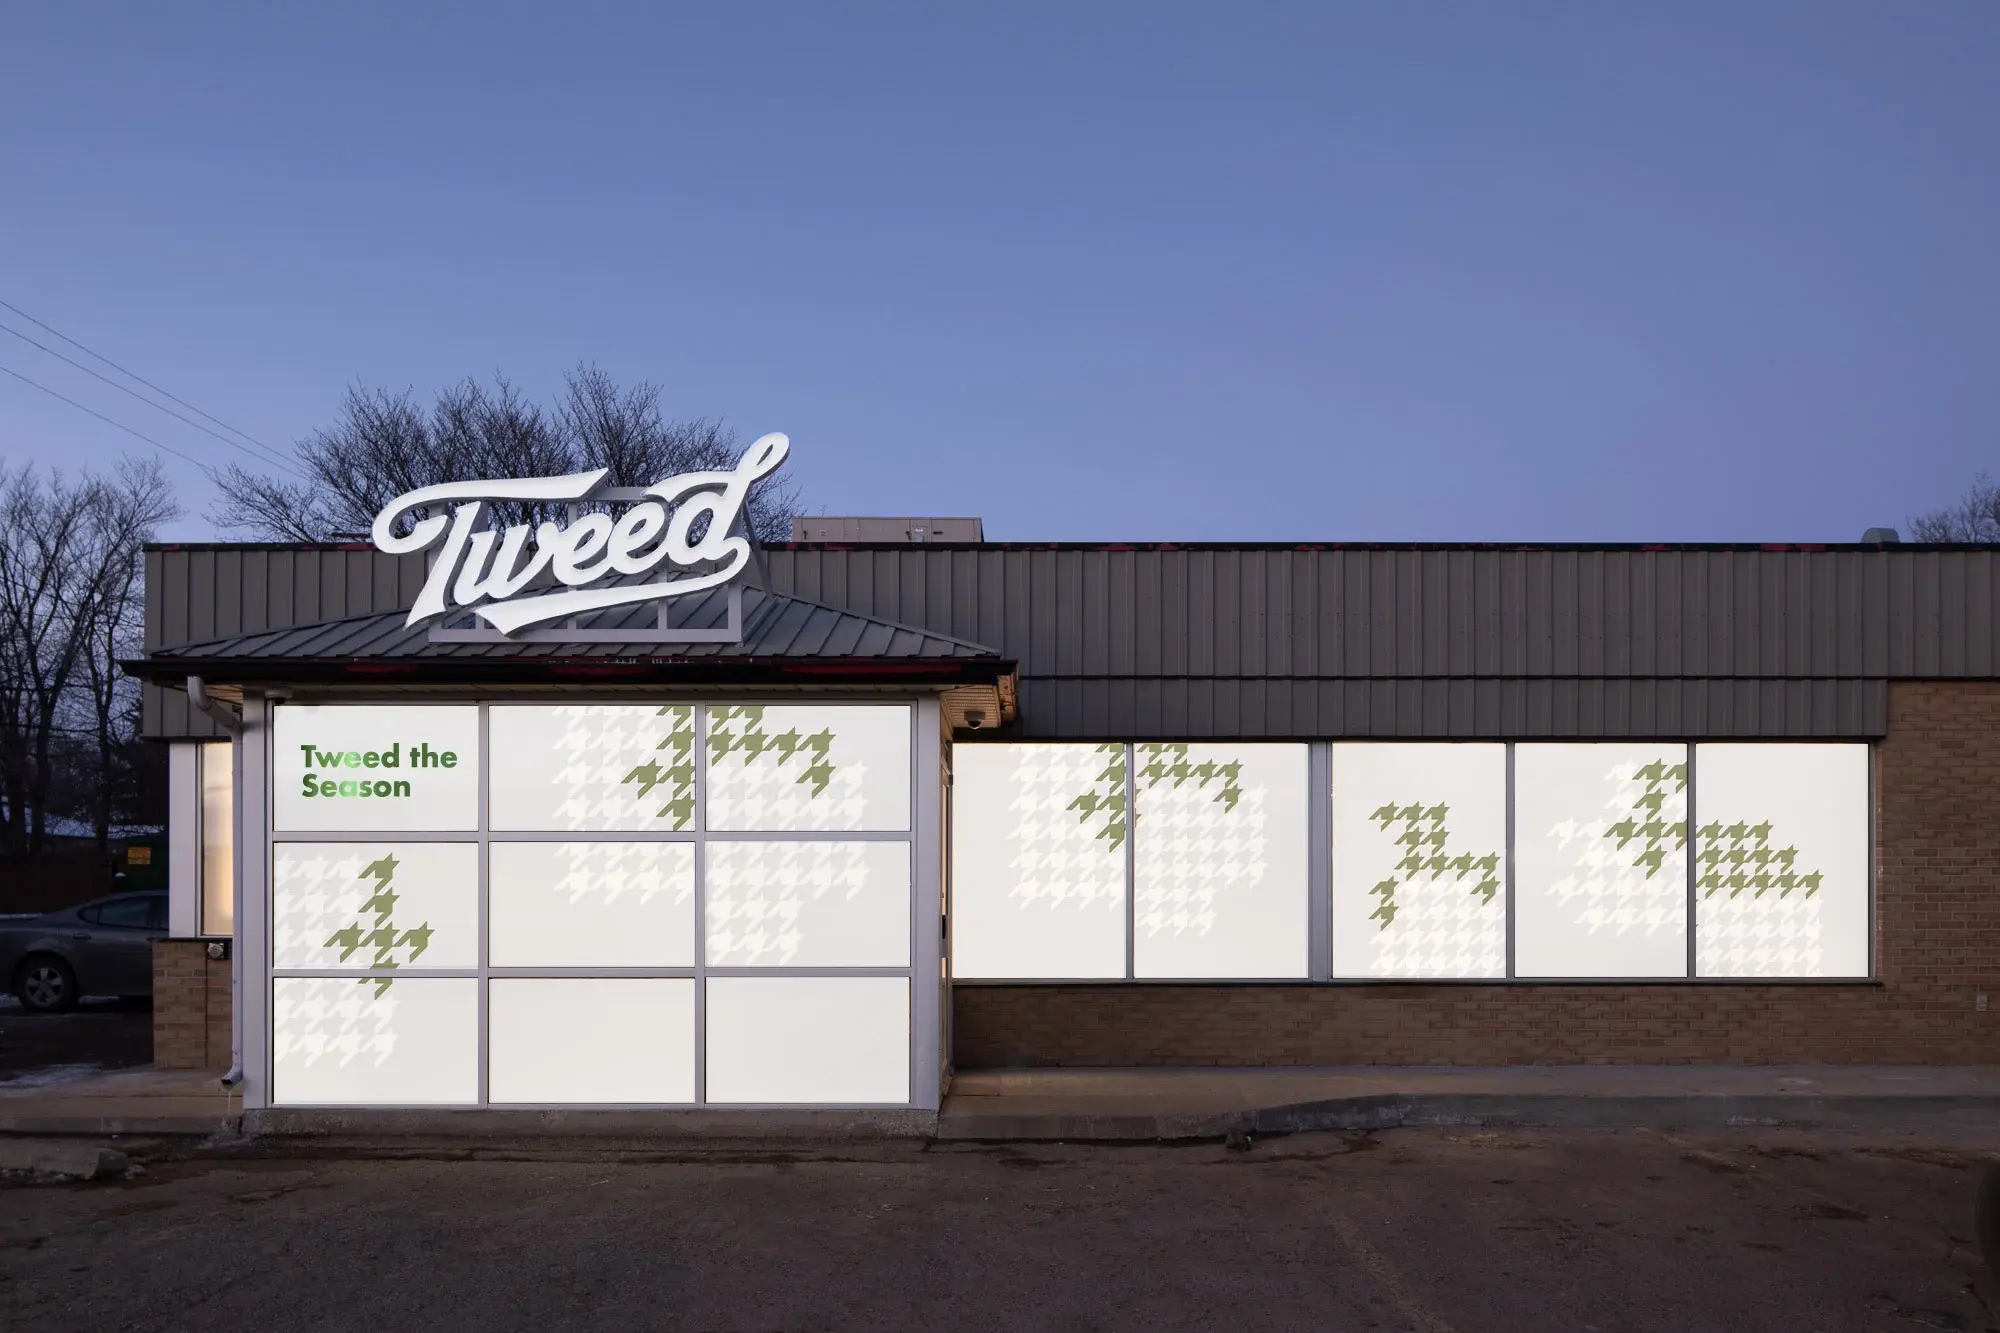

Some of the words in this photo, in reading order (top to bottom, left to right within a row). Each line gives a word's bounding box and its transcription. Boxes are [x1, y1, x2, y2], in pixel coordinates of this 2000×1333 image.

[372, 432, 790, 637] Tweed
[301, 743, 399, 768] Tweed
[410, 743, 458, 768] the
[302, 773, 411, 798] Season
